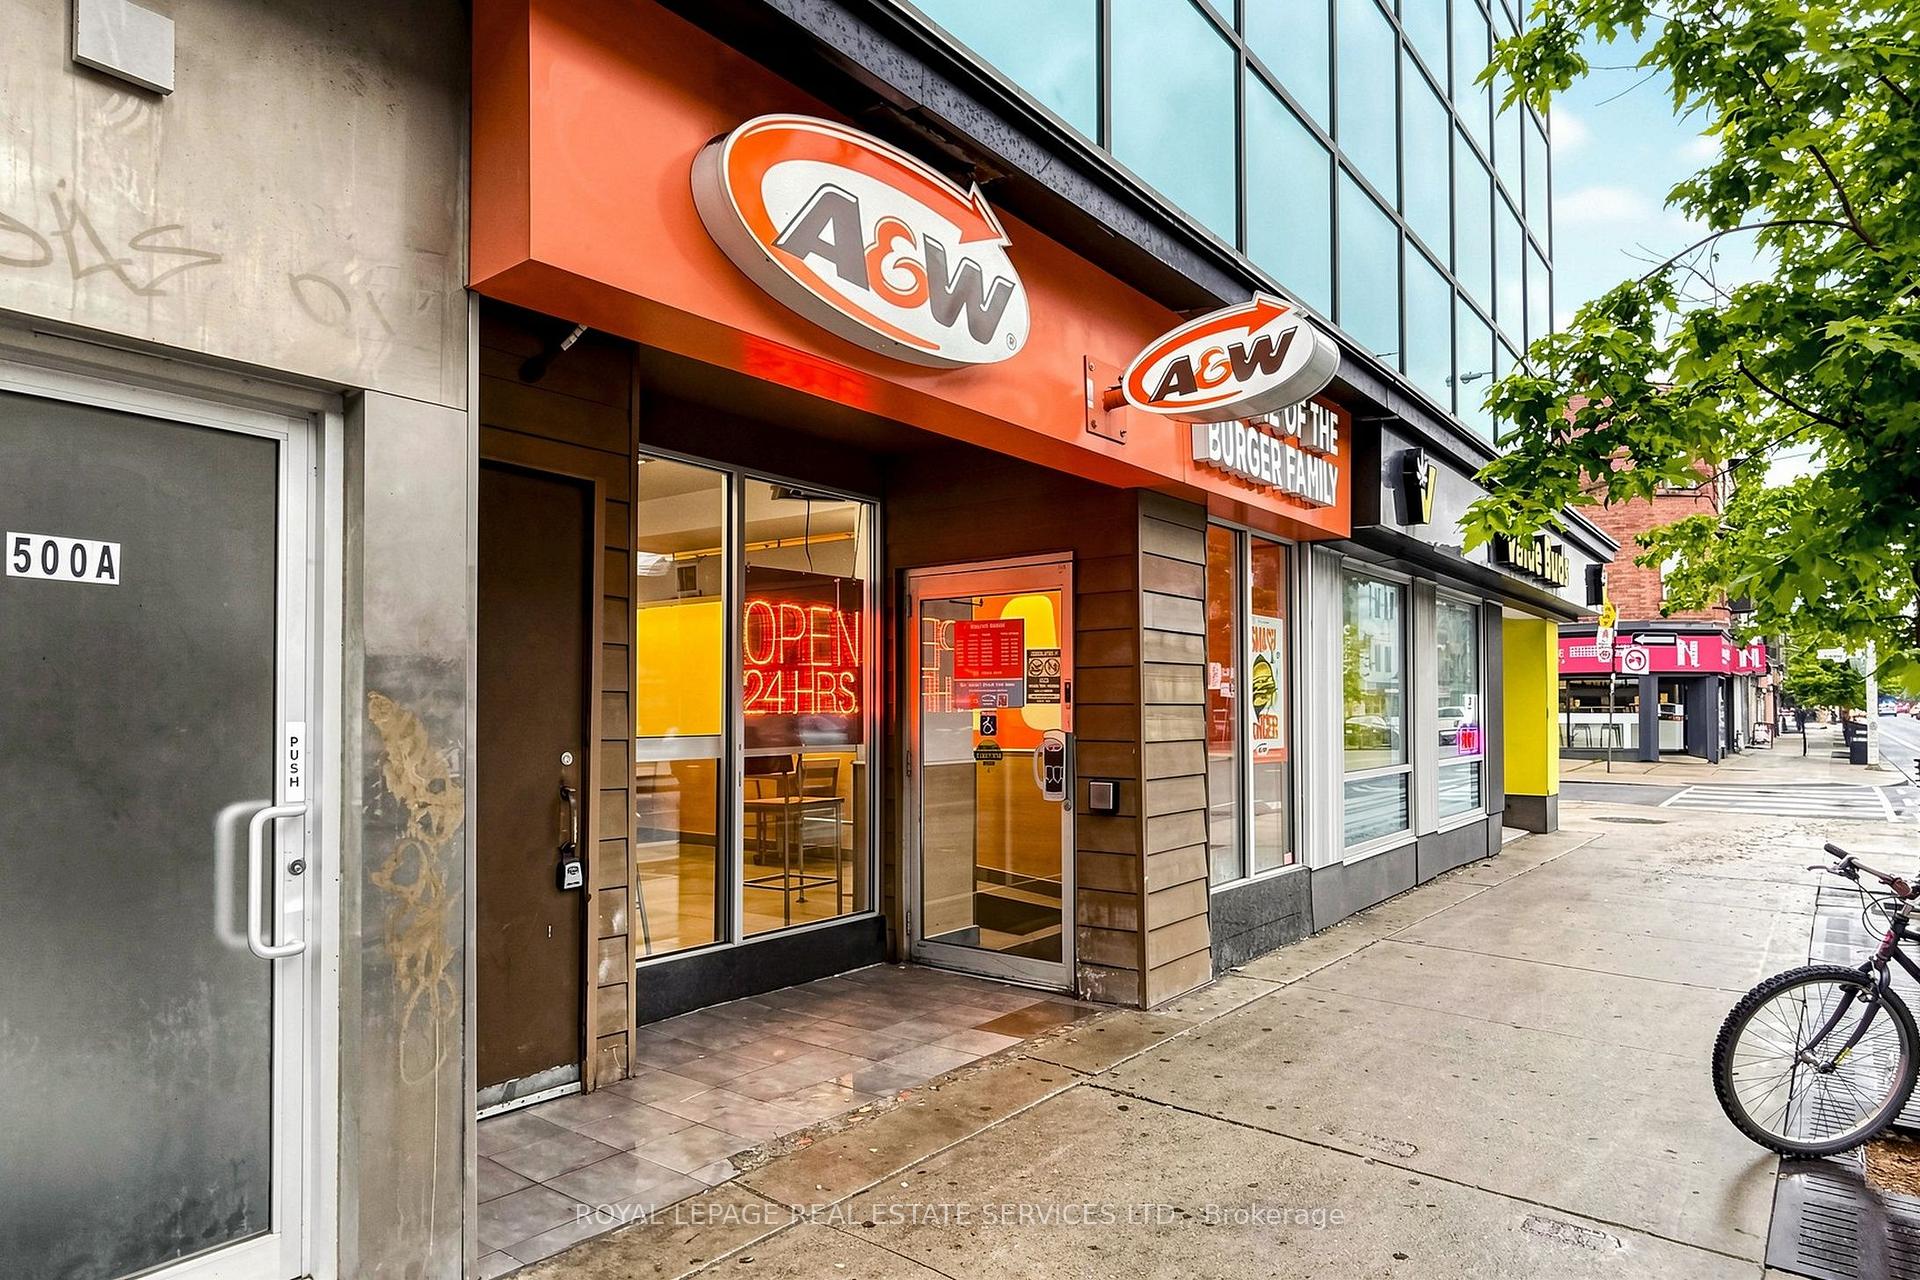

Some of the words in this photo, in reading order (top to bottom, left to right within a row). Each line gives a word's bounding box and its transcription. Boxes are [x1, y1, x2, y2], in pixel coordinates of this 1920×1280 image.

[771, 183, 1016, 345] A&W
[1148, 325, 1298, 403] A&W
[1284, 400, 1307, 438] OF
[1310, 401, 1339, 457] THE
[1208, 421, 1283, 490] BURGER
[1286, 444, 1339, 507] FAMILY
[13, 536, 116, 580] 500A
[1543, 534, 1569, 588] Buds
[742, 600, 859, 668] OPEN
[289, 736, 300, 788] PUSH
